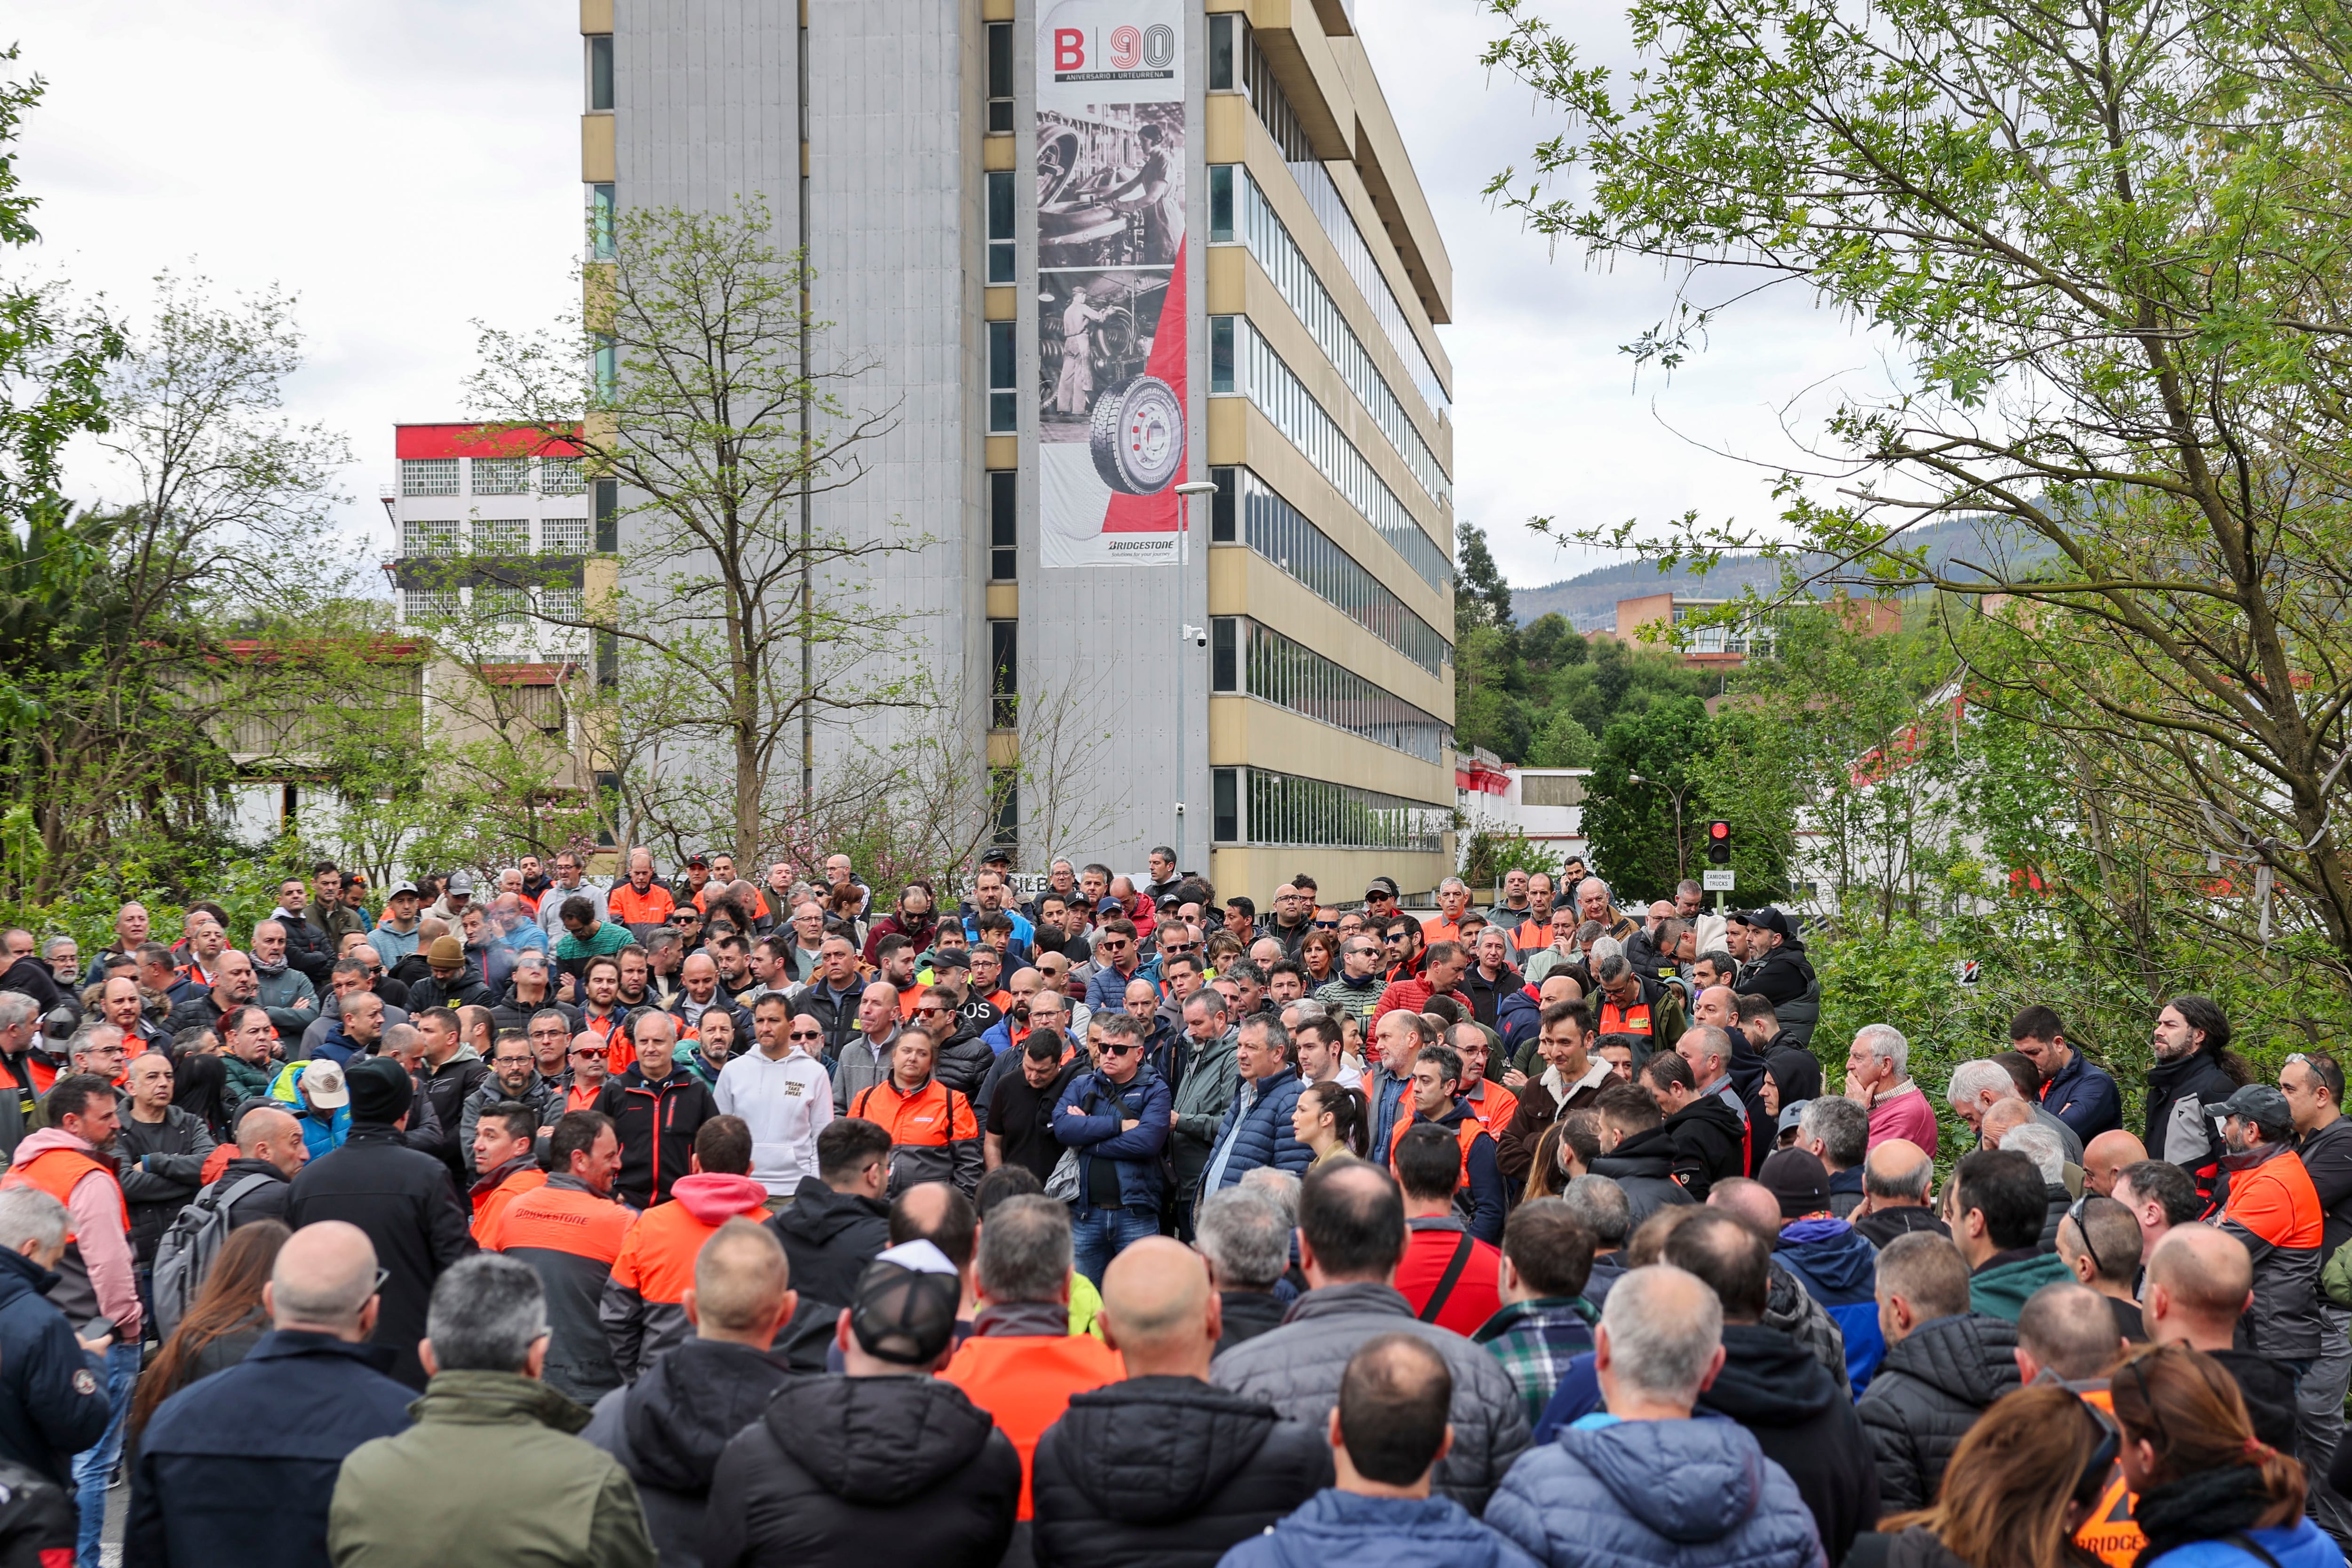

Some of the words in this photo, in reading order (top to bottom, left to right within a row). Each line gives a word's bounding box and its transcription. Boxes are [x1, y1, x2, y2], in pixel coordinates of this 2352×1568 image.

[1055, 28, 1085, 71] B
[1111, 24, 1174, 70] 90
[1136, 388, 1168, 401] DURAVIS
[1108, 541, 1174, 550] BRIDGESTONE
